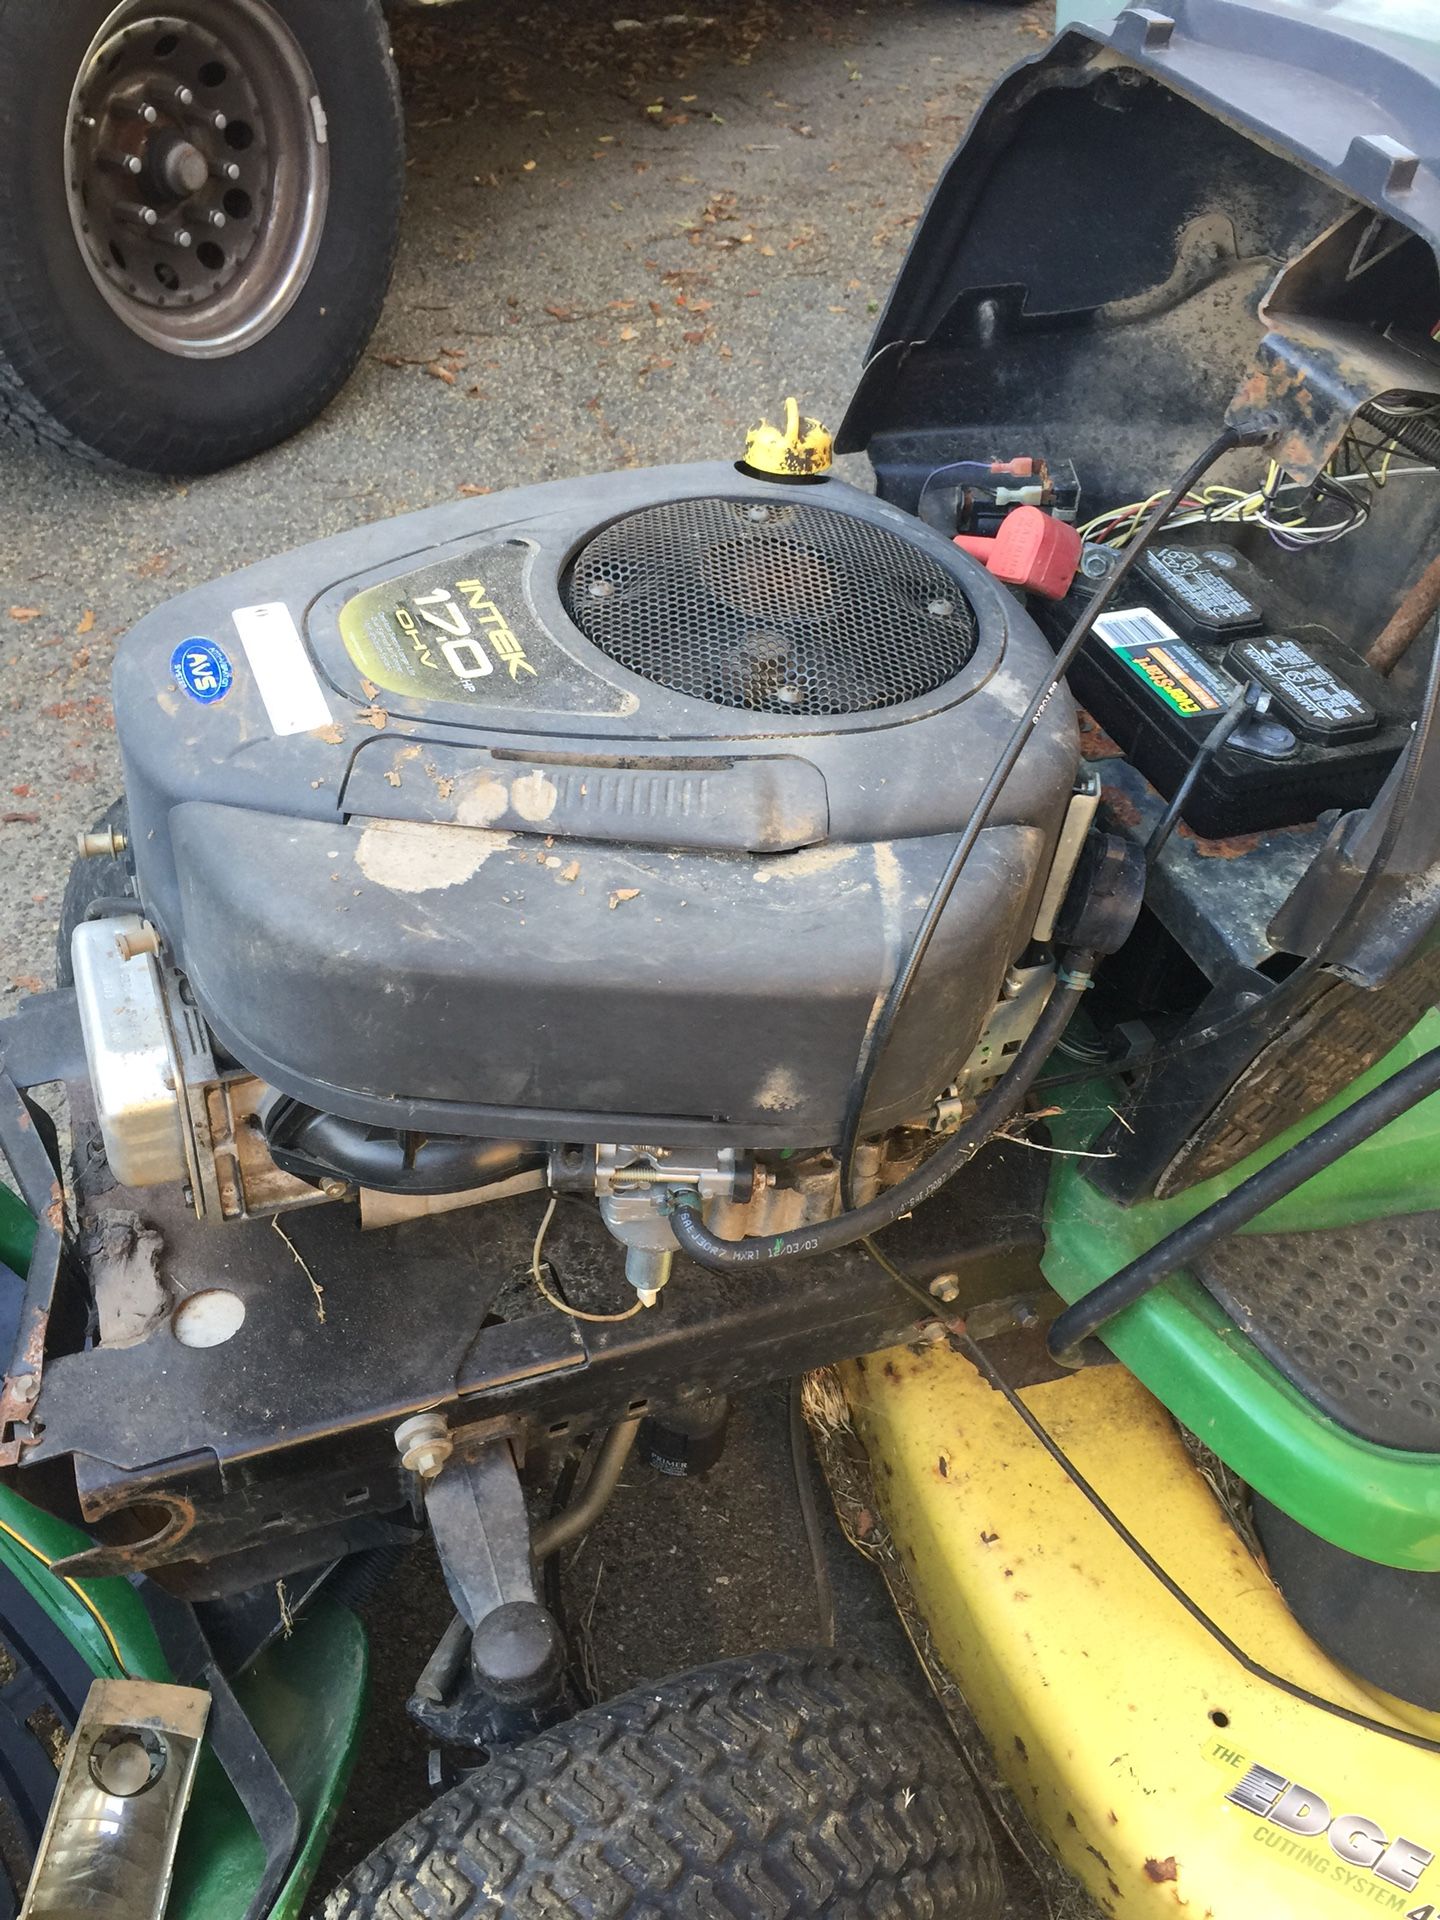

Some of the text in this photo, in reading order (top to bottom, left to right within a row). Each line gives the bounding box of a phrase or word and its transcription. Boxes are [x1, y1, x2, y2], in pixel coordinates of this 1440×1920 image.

[395, 609, 438, 670] OHV
[414, 587, 493, 679] 17.0
[456, 578, 538, 680] INTEK
[187, 653, 218, 691] AVS
[1132, 656, 1202, 713] EverStart
[1243, 648, 1279, 676] POISON
[1279, 681, 1317, 712] DANGER
[650, 1452, 688, 1468] PRIMER
[1211, 1743, 1246, 1769] THE
[1224, 1761, 1436, 1894] EDGE
[1252, 1826, 1408, 1913] CUTTING SYSTEM
